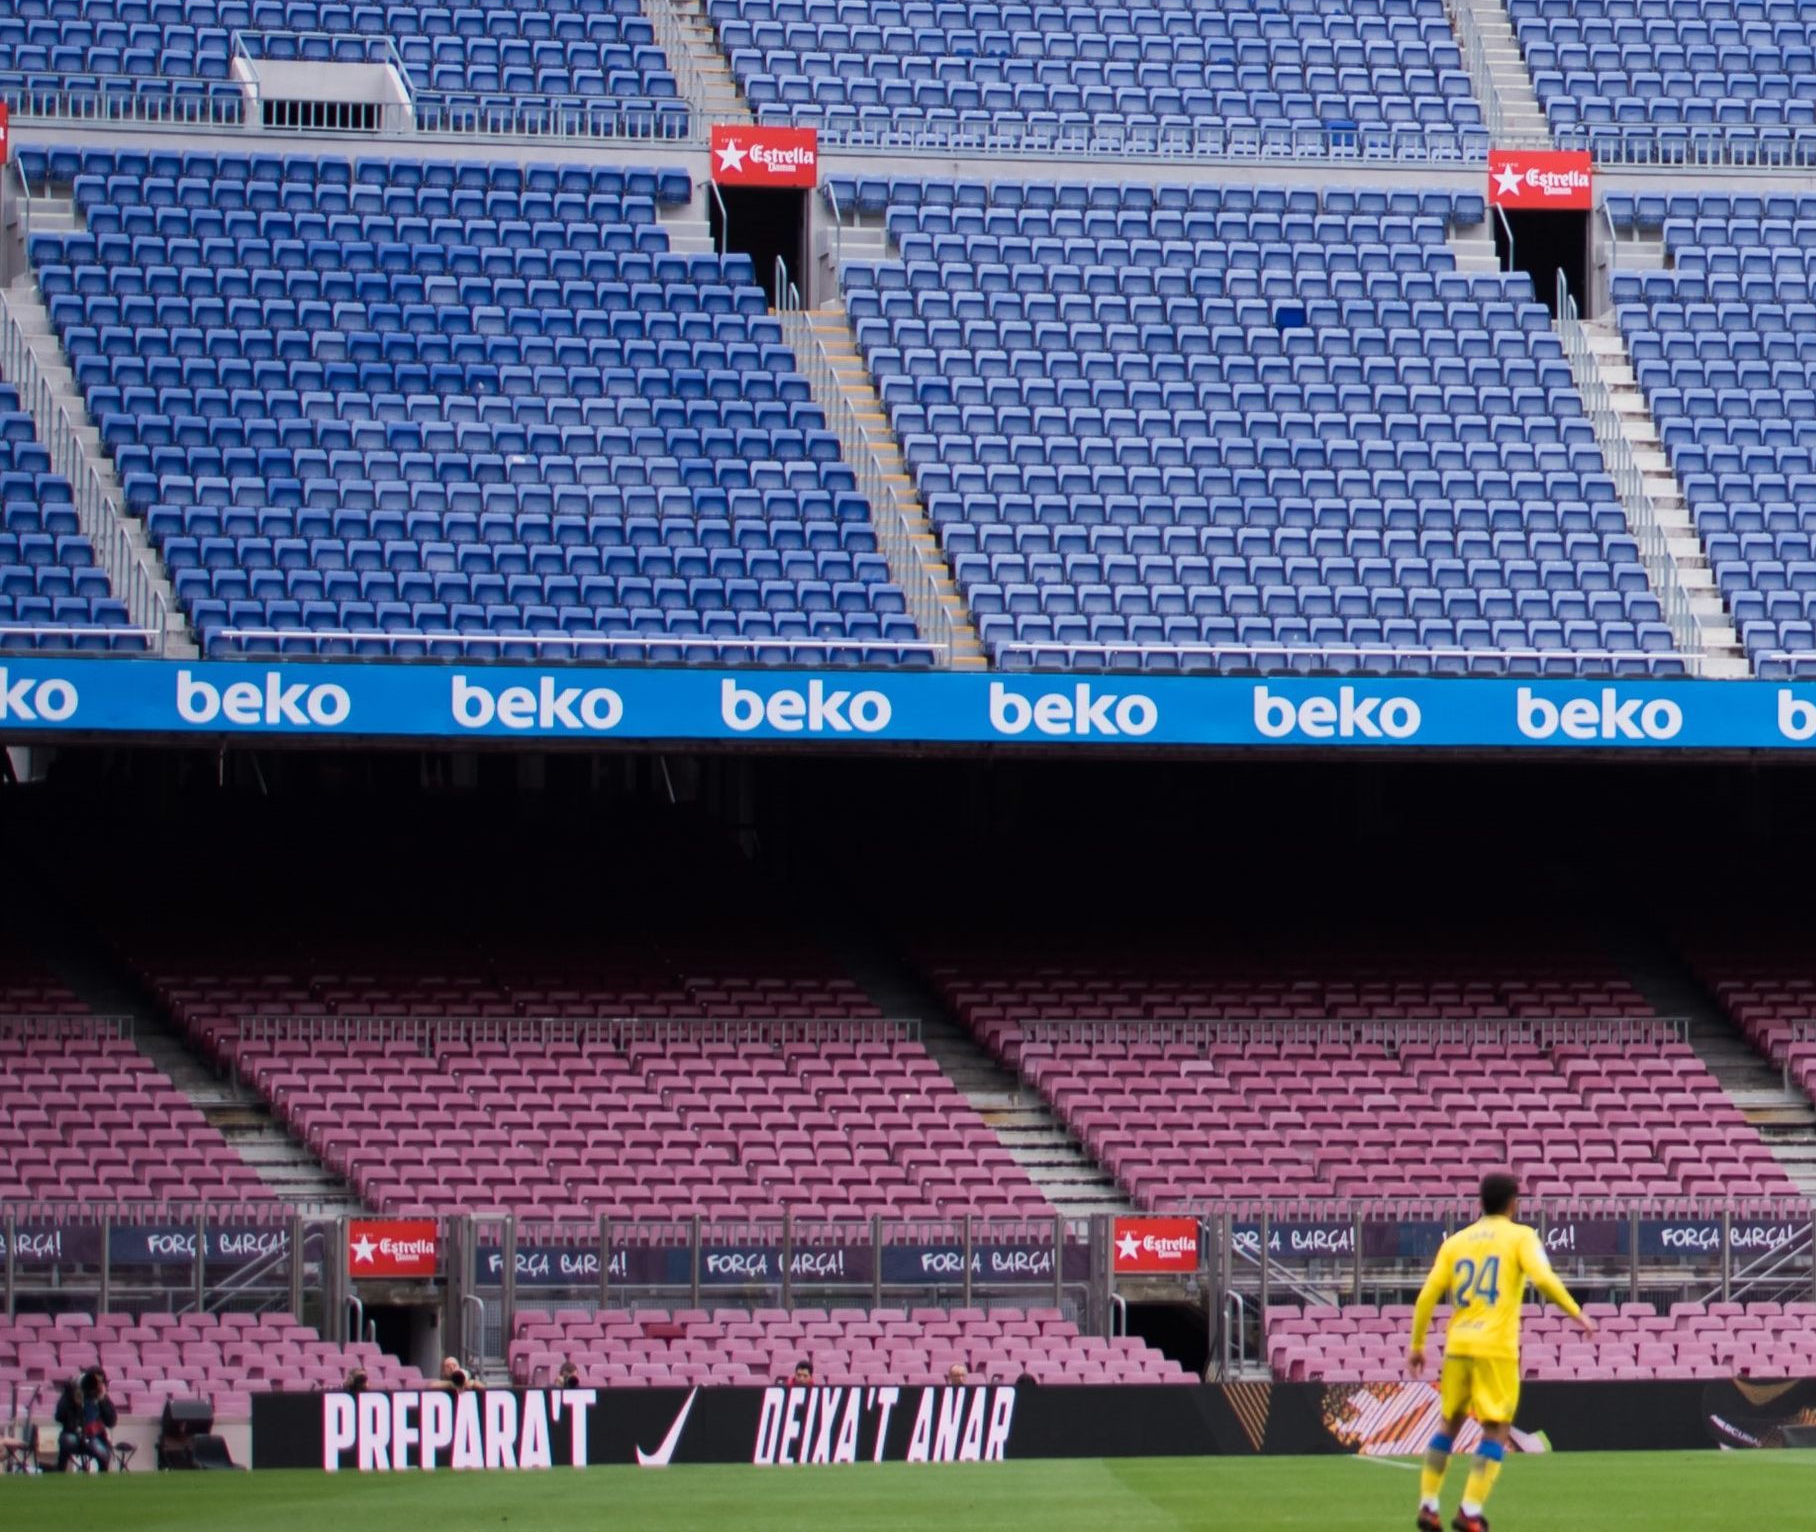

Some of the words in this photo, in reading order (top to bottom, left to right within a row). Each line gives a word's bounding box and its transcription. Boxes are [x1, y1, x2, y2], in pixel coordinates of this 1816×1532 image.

[749, 144, 814, 164] Estrella
[1525, 168, 1590, 187] Estrella
[177, 671, 350, 725] beko
[452, 676, 622, 729] beko
[722, 679, 891, 731] beko
[990, 683, 1157, 735] beko
[1254, 686, 1420, 737] beko
[1518, 688, 1682, 739] beko
[380, 1238, 434, 1254] Estrella
[489, 1254, 549, 1277] FRÇA
[561, 1251, 627, 1277] BARA!
[1143, 1235, 1196, 1252] Estrella
[1291, 1227, 1355, 1252] BARÇA!
[1662, 1227, 1719, 1250] FORÇA
[707, 1253, 768, 1276] FORÇA
[1454, 1256, 1500, 1309] 24
[324, 1389, 597, 1471] PREPARA'T
[754, 1386, 900, 1464] DEIXA'T
[907, 1386, 1016, 1462] ANAR
